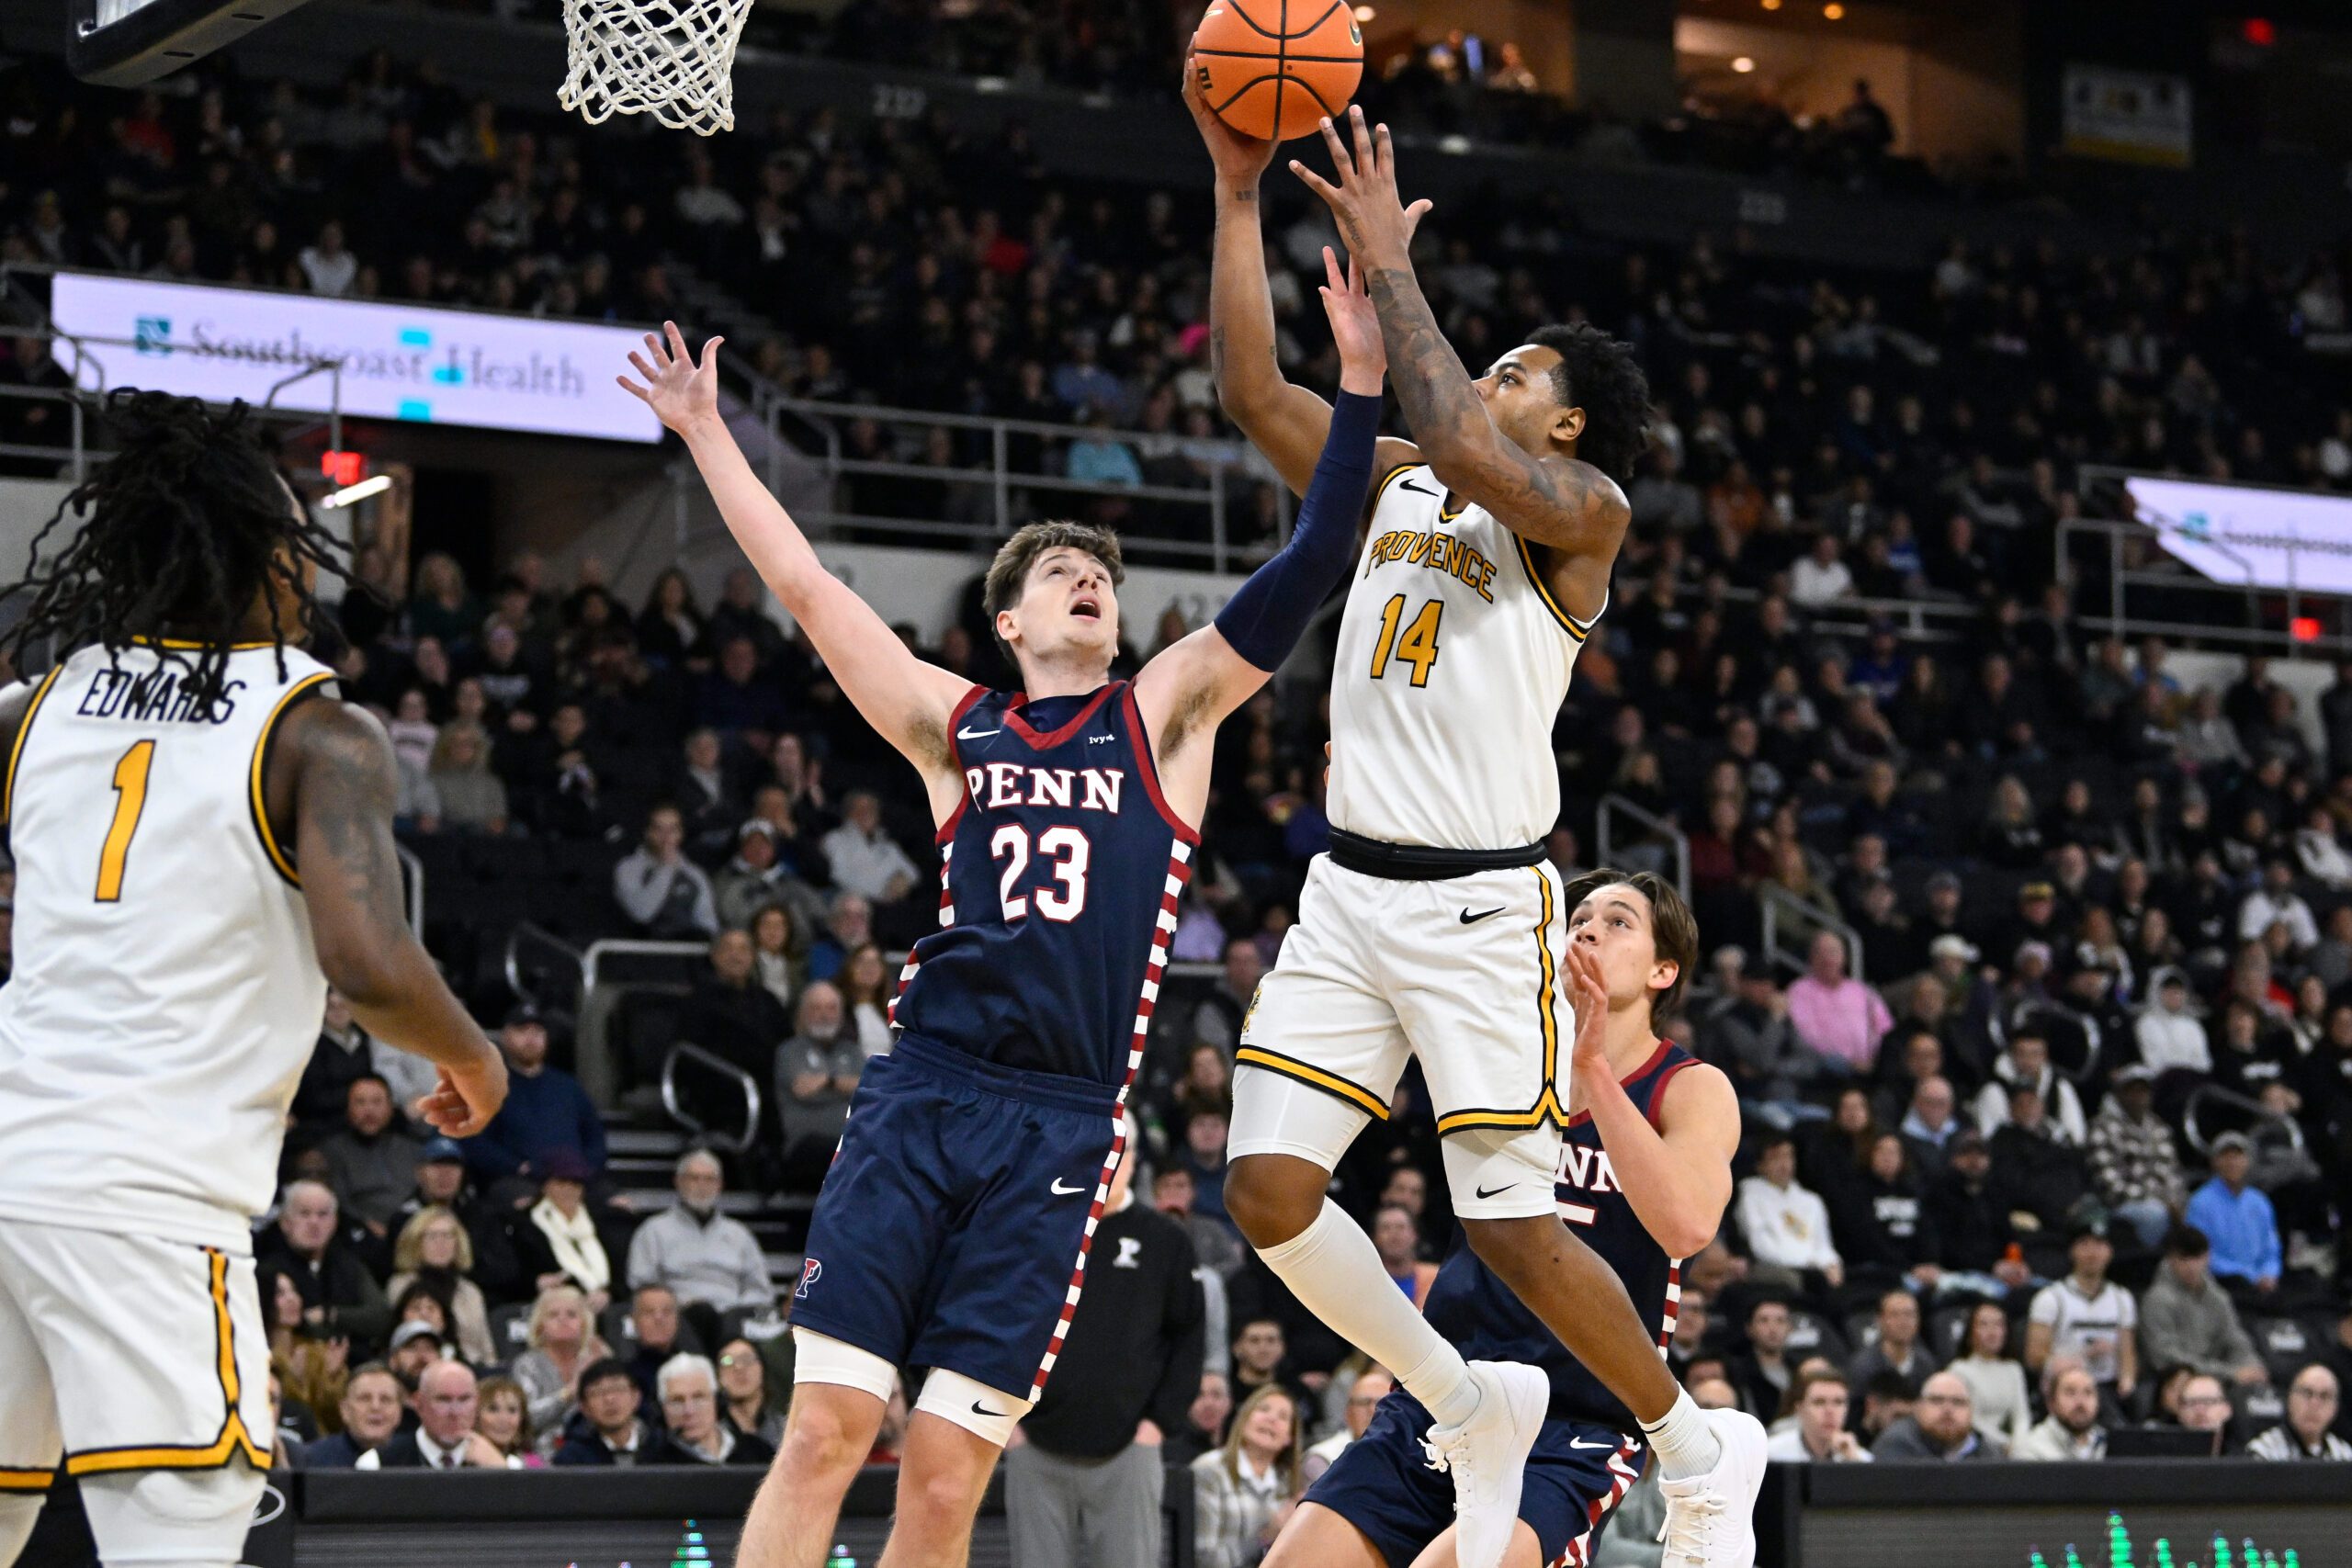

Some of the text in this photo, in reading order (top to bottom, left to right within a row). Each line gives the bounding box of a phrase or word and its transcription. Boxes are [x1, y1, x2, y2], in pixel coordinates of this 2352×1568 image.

[1364, 529, 1498, 604] PROVENCE
[1370, 593, 1445, 689] 14
[1088, 735, 1106, 745] Ivy
[966, 761, 1124, 815] PENN
[95, 739, 156, 902] 1
[989, 822, 1091, 923] 23
[1554, 1141, 1623, 1193] NN
[795, 1258, 822, 1298] P
[1113, 1236, 1142, 1269] P
